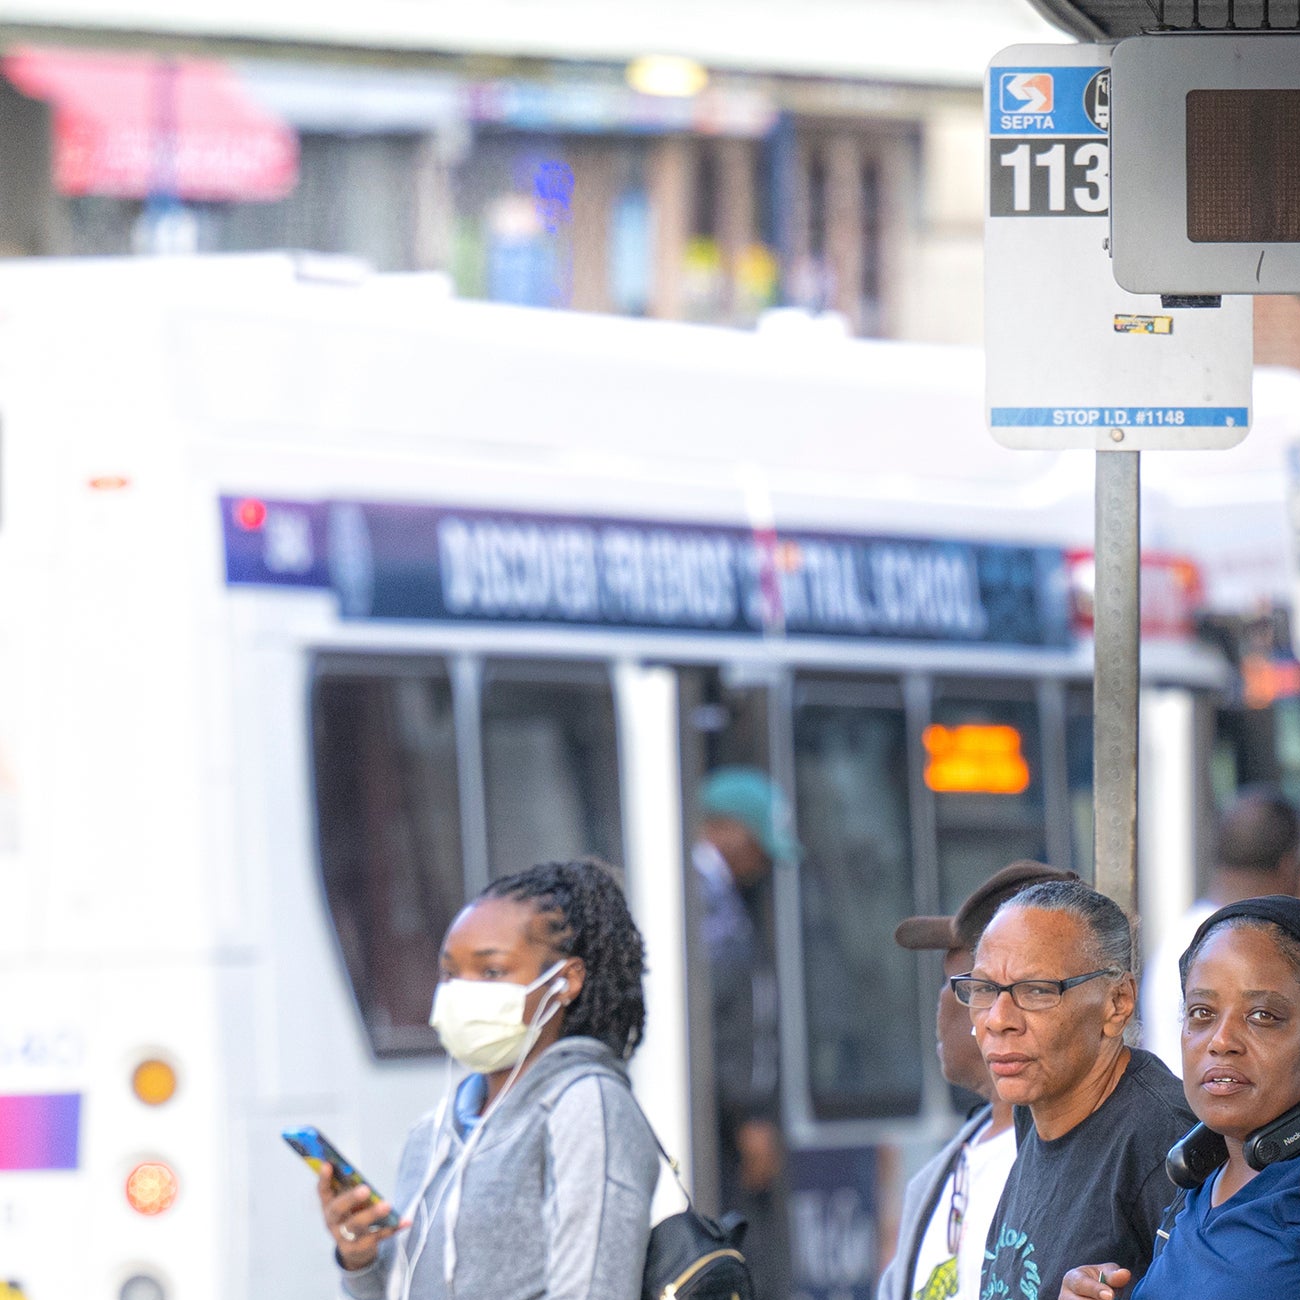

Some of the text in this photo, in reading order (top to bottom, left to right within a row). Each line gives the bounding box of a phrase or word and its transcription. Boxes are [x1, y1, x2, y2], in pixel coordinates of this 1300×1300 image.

[1001, 115, 1054, 129] SEPTA
[1001, 143, 1109, 212] 113
[1053, 410, 1185, 424] STOP I.D. #1148
